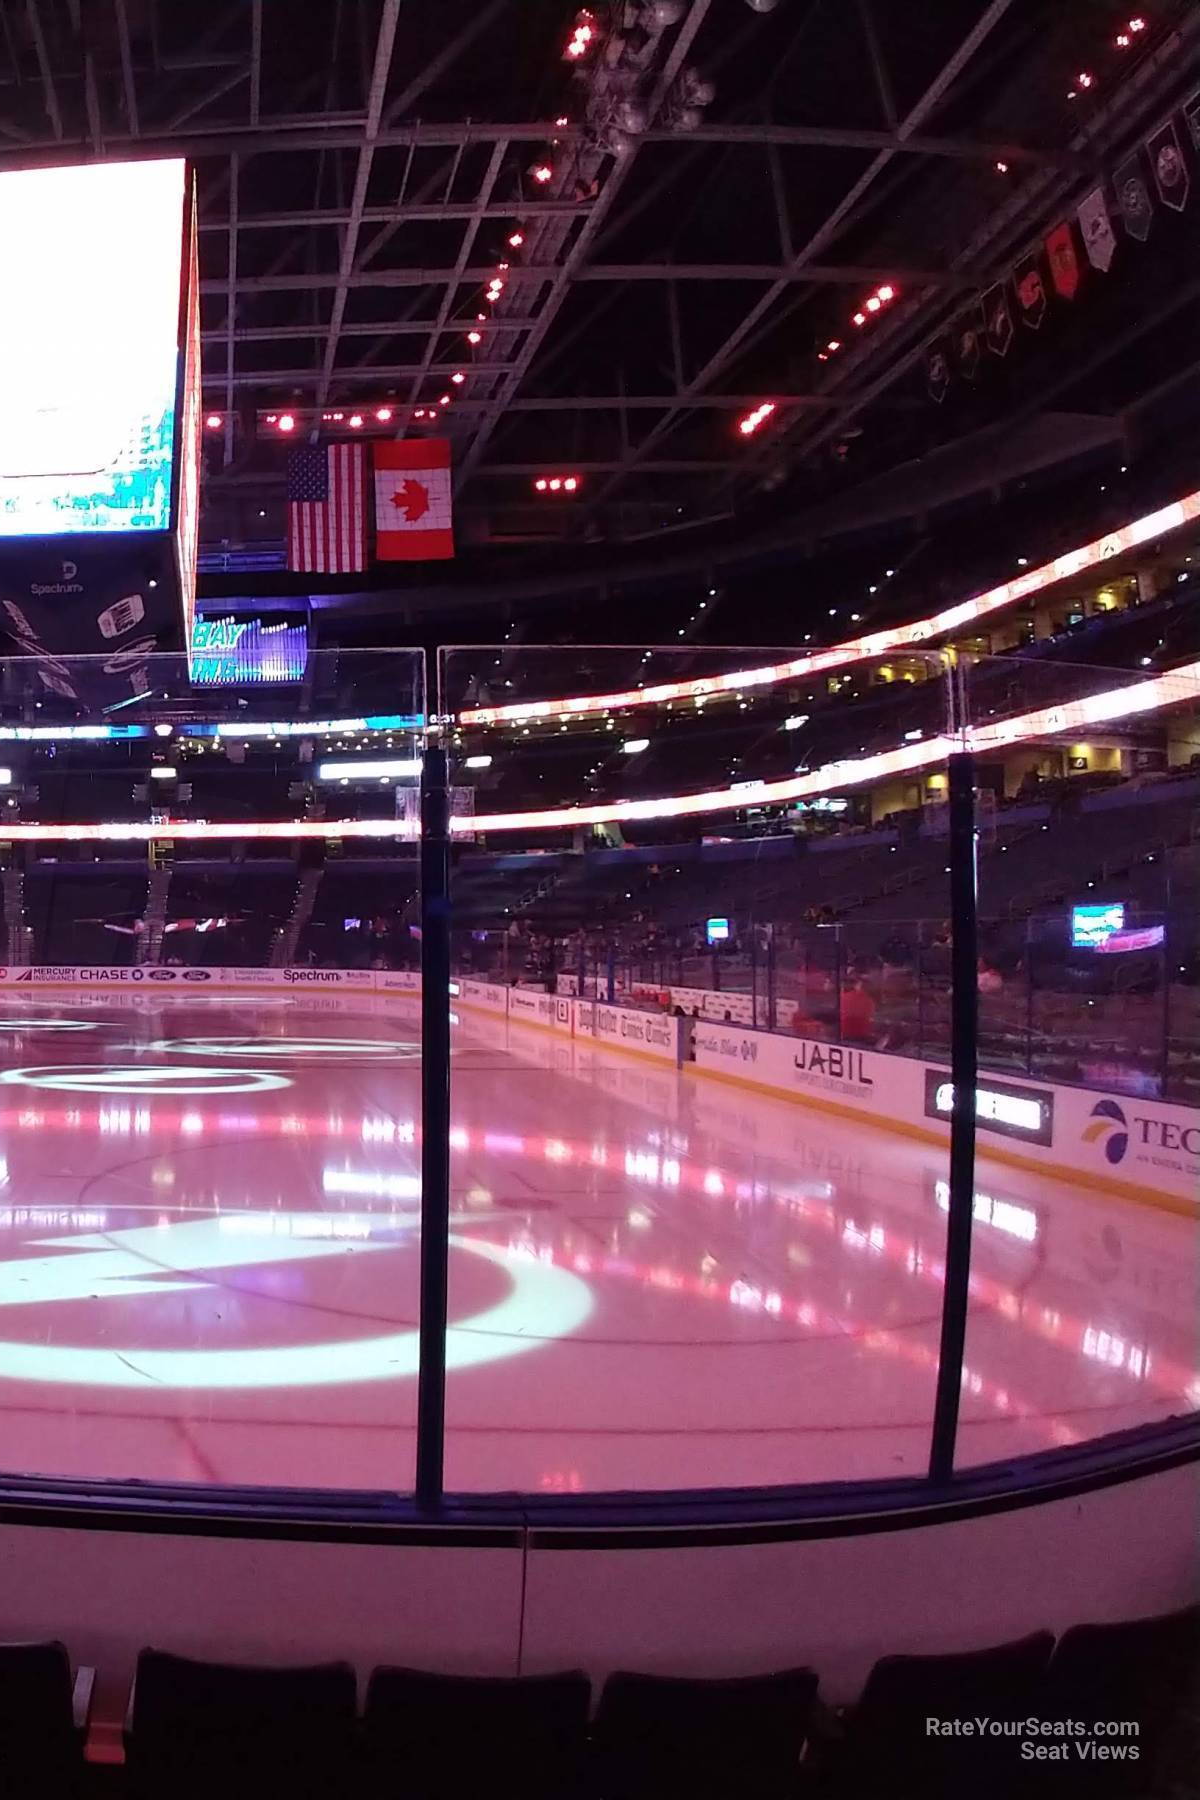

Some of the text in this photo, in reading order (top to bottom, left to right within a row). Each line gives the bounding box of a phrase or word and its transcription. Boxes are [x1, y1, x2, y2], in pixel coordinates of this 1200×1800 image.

[31, 584, 80, 596] Spectrum
[192, 621, 247, 651] BAY
[80, 969, 129, 980] CHASE
[283, 969, 338, 983] Spectrum
[794, 1042, 873, 1085] JABIL
